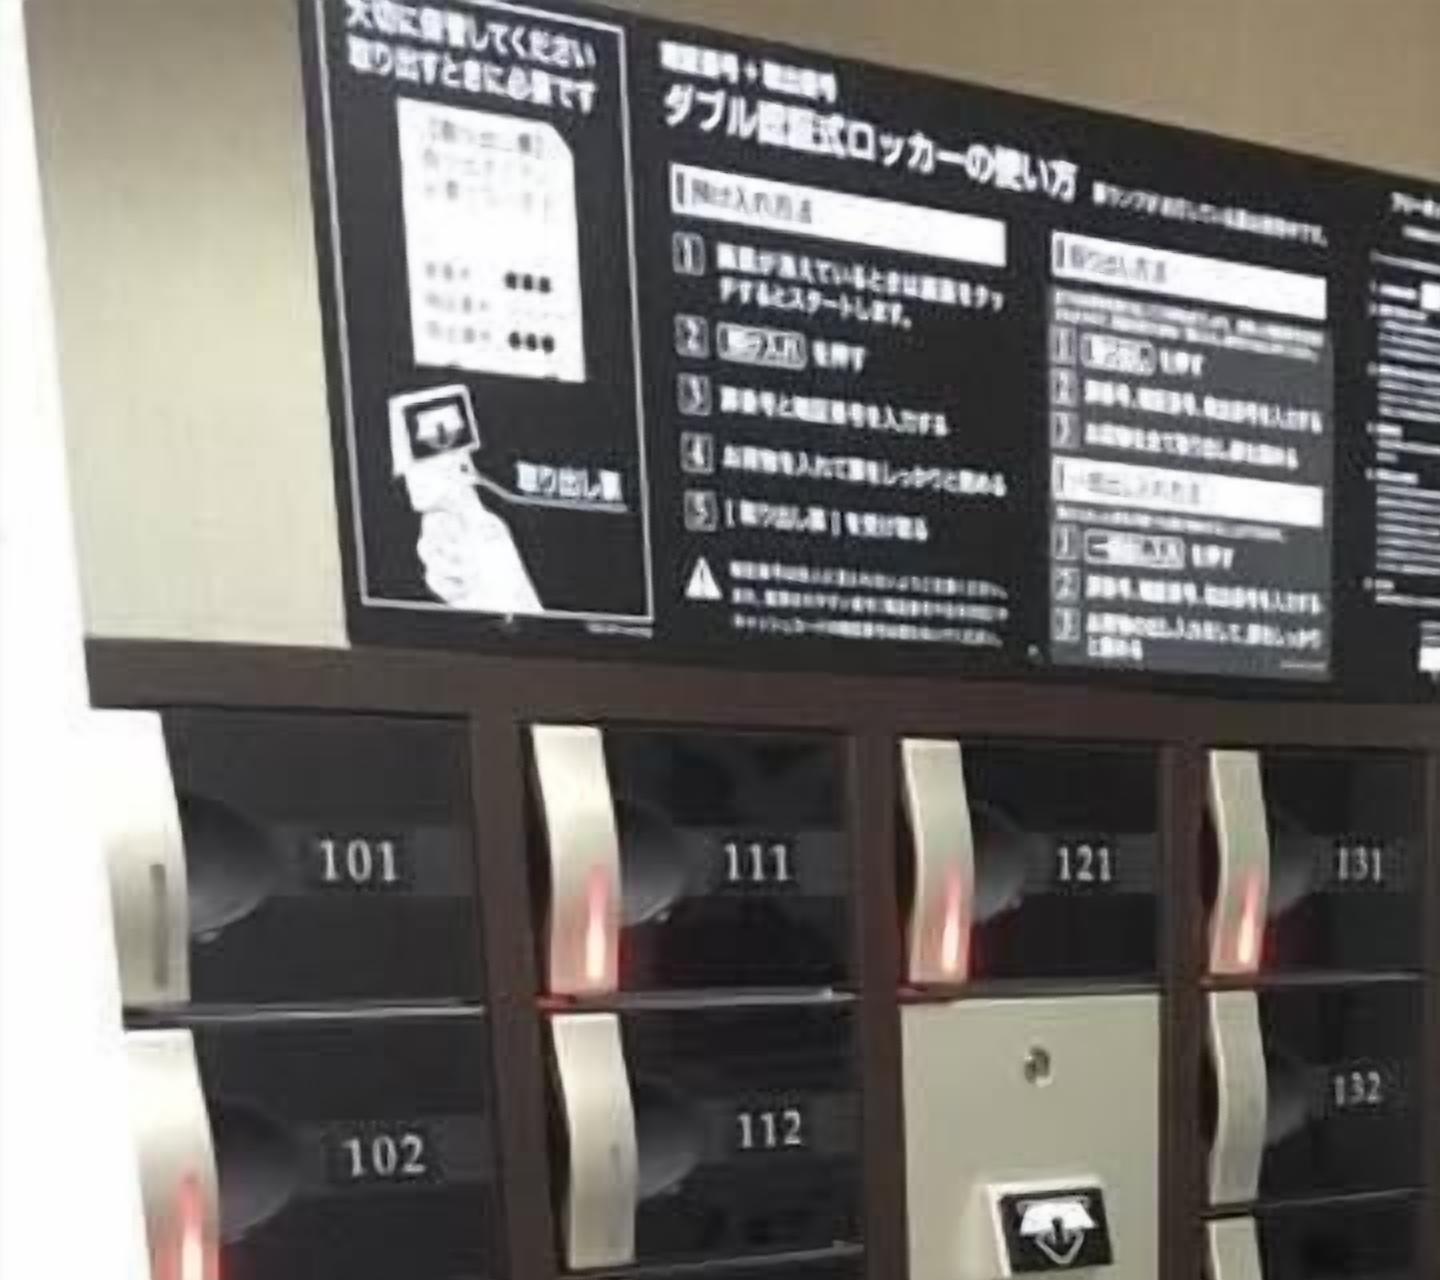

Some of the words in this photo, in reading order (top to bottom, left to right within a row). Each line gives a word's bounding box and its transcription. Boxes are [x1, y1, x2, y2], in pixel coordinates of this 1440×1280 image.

[319, 839, 396, 882] 101
[724, 842, 788, 882] 111
[1058, 844, 1111, 882] 121
[1338, 846, 1382, 882] 131
[1334, 1070, 1382, 1106] 132
[738, 1109, 802, 1148] 112
[344, 1133, 425, 1177] 102
